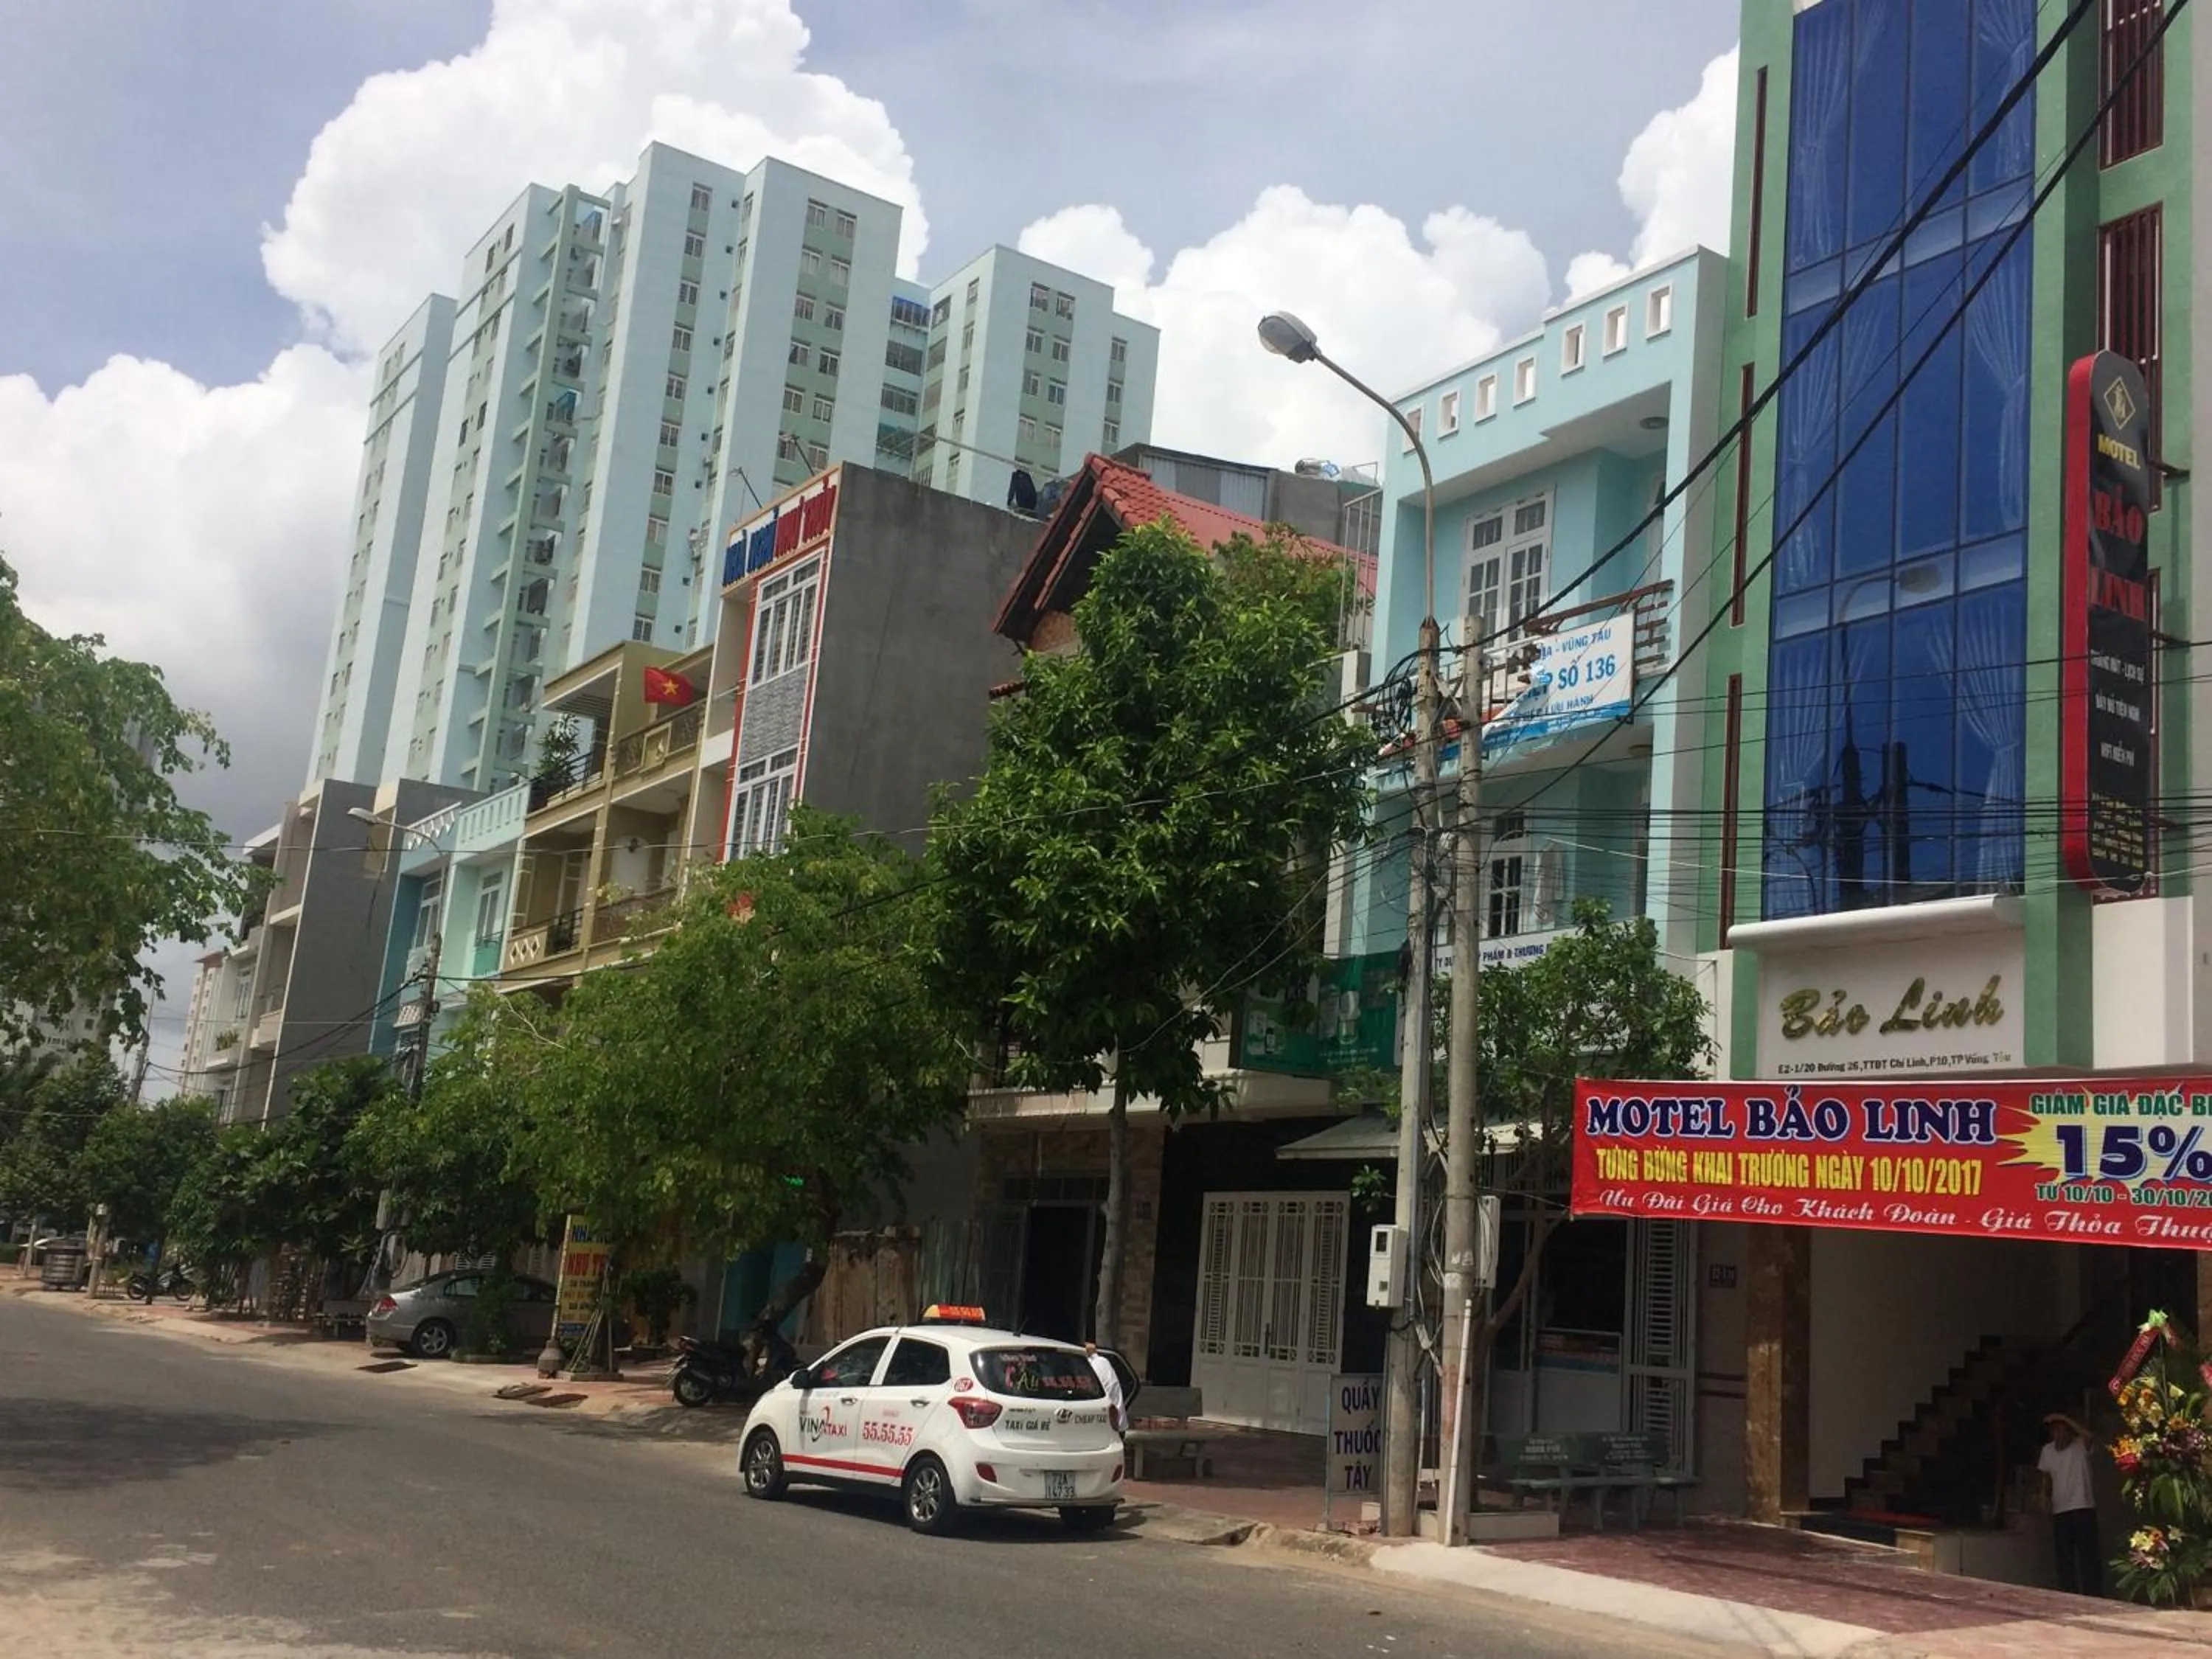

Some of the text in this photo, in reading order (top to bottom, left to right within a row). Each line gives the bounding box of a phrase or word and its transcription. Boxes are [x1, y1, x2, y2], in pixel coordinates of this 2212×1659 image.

[2098, 434, 2140, 469] MOTEL
[2095, 484, 2143, 544] BẢO
[1557, 658, 1579, 690] SỐ
[1586, 653, 1615, 683] 136
[1879, 974, 2005, 1034] Linh
[1586, 1085, 1997, 1144] MOTEL BẢO LINH
[2031, 1089, 2086, 1116] GIẢM
[2093, 1091, 2130, 1116] GIÁ
[2137, 1088, 2184, 1120] ĐẶC
[2056, 1124, 2212, 1182] 15%
[1693, 1151, 1733, 1185] KHAI
[1815, 1150, 1865, 1191] NGÀY
[1869, 1156, 1983, 1196] 10/10/2017
[2065, 1184, 2113, 1203] 10/10
[1691, 1193, 1733, 1215] Giá
[1741, 1194, 1783, 1215] Cho
[1792, 1198, 1874, 1221] Khách
[1883, 1203, 1957, 1227] Đoàn
[1980, 1206, 2033, 1233] Giá
[863, 1421, 914, 1446] 55.55.55
[1344, 1461, 1372, 1490] TÂY
